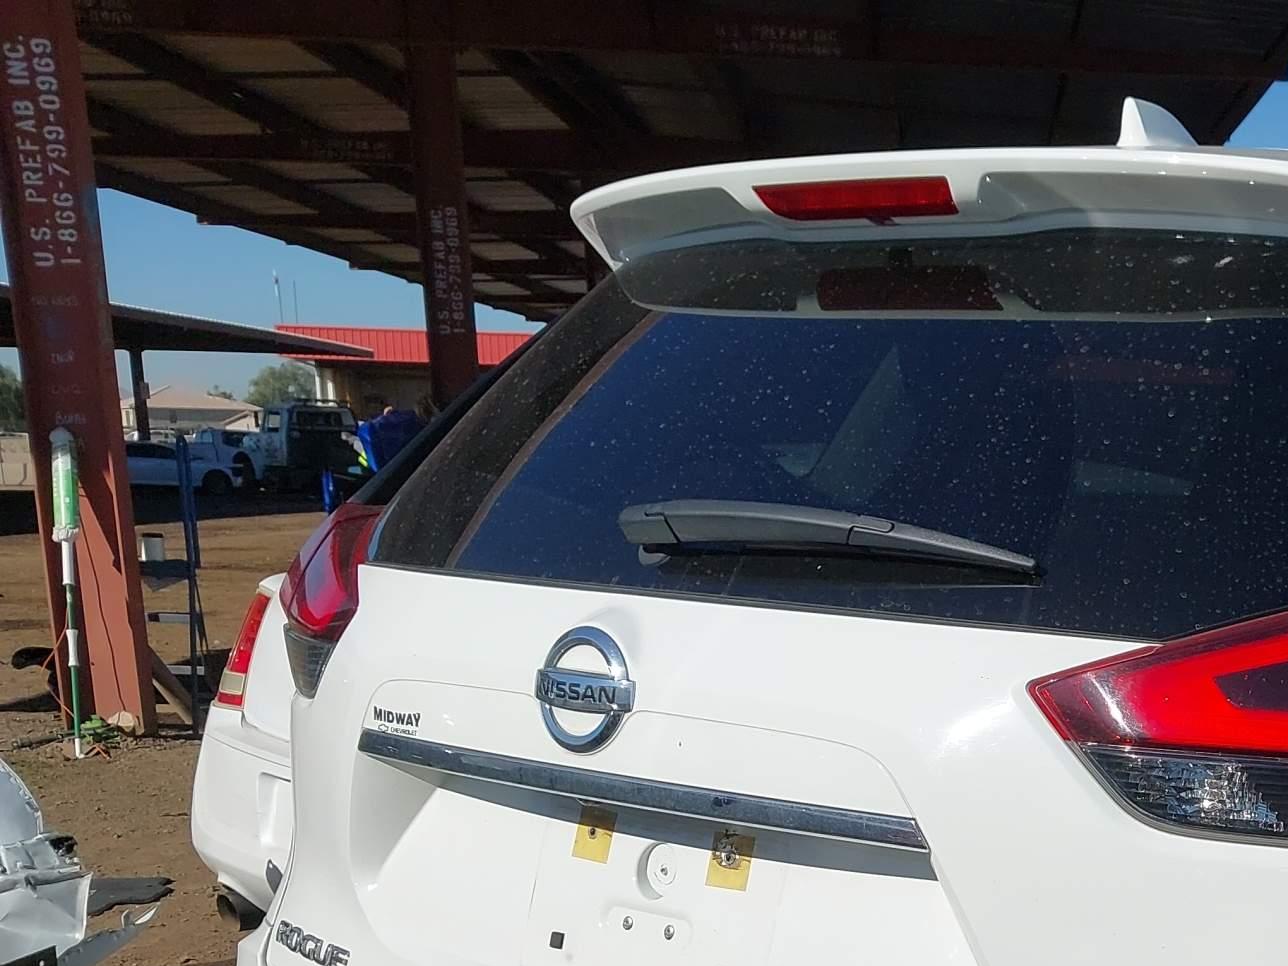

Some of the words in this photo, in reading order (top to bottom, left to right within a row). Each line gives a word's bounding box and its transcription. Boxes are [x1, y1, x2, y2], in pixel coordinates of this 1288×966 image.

[3, 35, 31, 86] INC.
[12, 100, 48, 202] PREFAB
[29, 38, 82, 264] 1-866-799-0969
[30, 218, 55, 268] U.S.
[432, 241, 448, 298] PREFAB
[373, 705, 421, 728] MIDWAY
[541, 679, 616, 704] NISSAN
